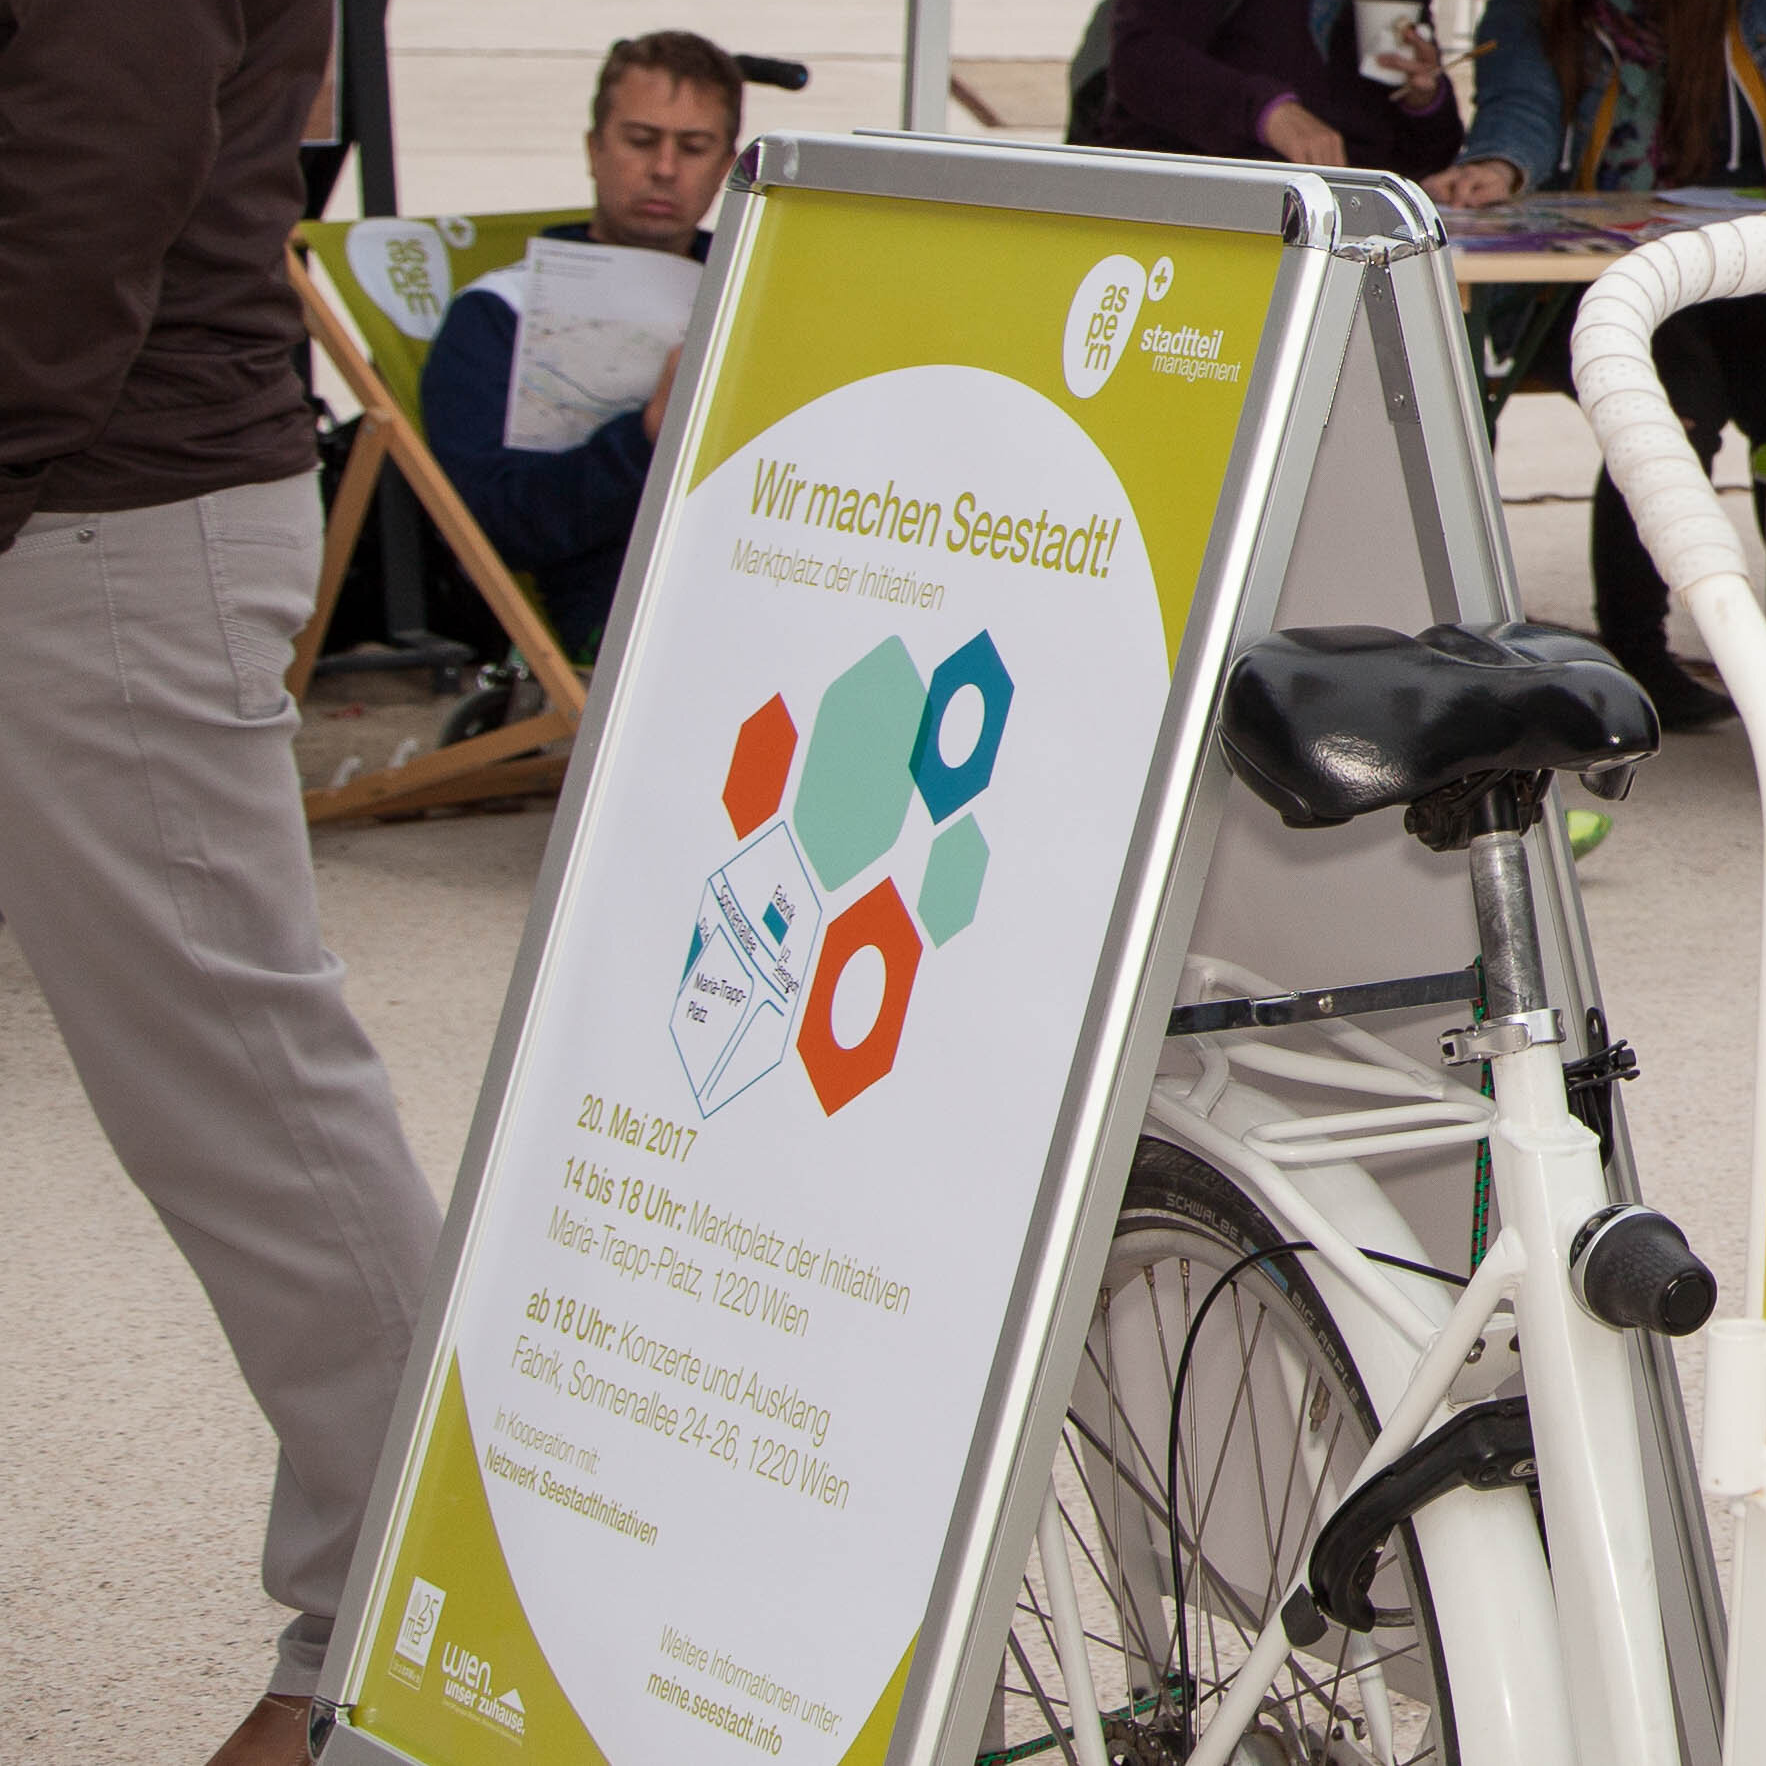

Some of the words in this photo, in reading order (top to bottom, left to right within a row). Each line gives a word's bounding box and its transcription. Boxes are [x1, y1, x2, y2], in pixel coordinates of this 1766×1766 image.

[1140, 324, 1224, 360] stadtteil
[1152, 354, 1241, 382] management
[750, 457, 806, 521] Wir
[803, 479, 943, 548] machen
[946, 490, 1122, 579] Seestadt!
[730, 538, 823, 588] Marktplatz
[824, 555, 858, 594] der
[857, 561, 945, 611] Initiativen
[772, 884, 797, 925] Fabrik
[686, 1000, 709, 1024] Platz
[693, 972, 747, 1008] Maria-Trapp-
[576, 1093, 604, 1134] 20.
[606, 1102, 650, 1148] Mai
[645, 1117, 699, 1163] 2017
[562, 1155, 588, 1194] 14
[585, 1162, 616, 1206] bis
[617, 1174, 645, 1215] 18
[644, 1183, 687, 1232] Uhr:
[686, 1199, 786, 1269] Marktplatz
[784, 1238, 821, 1281] der
[819, 1247, 912, 1316] Initiativen
[546, 1204, 704, 1304] Maria-Trapp-Platz,
[712, 1267, 761, 1318] 1220
[760, 1284, 810, 1339] Wien
[525, 1286, 551, 1324] ab
[551, 1294, 577, 1335] 18
[575, 1303, 617, 1352] Uhr:
[616, 1320, 702, 1387] Konzerte
[702, 1365, 745, 1402] und
[739, 1371, 831, 1448] Ausklang
[493, 1404, 507, 1433] In
[505, 1409, 576, 1466] Kooperation
[510, 1334, 564, 1394] Fabrik,
[567, 1359, 679, 1438] Sonnenallee
[677, 1406, 742, 1471] 24-26,
[748, 1434, 800, 1487] 1220
[798, 1453, 851, 1511] Wien
[484, 1442, 540, 1493] Netzwerk
[444, 1679, 479, 1708] unser
[646, 1672, 783, 1756] meine.seestadt.info
[659, 1622, 709, 1673] Weitere
[709, 1649, 801, 1716] Informationen
[801, 1699, 843, 1737] unter:
